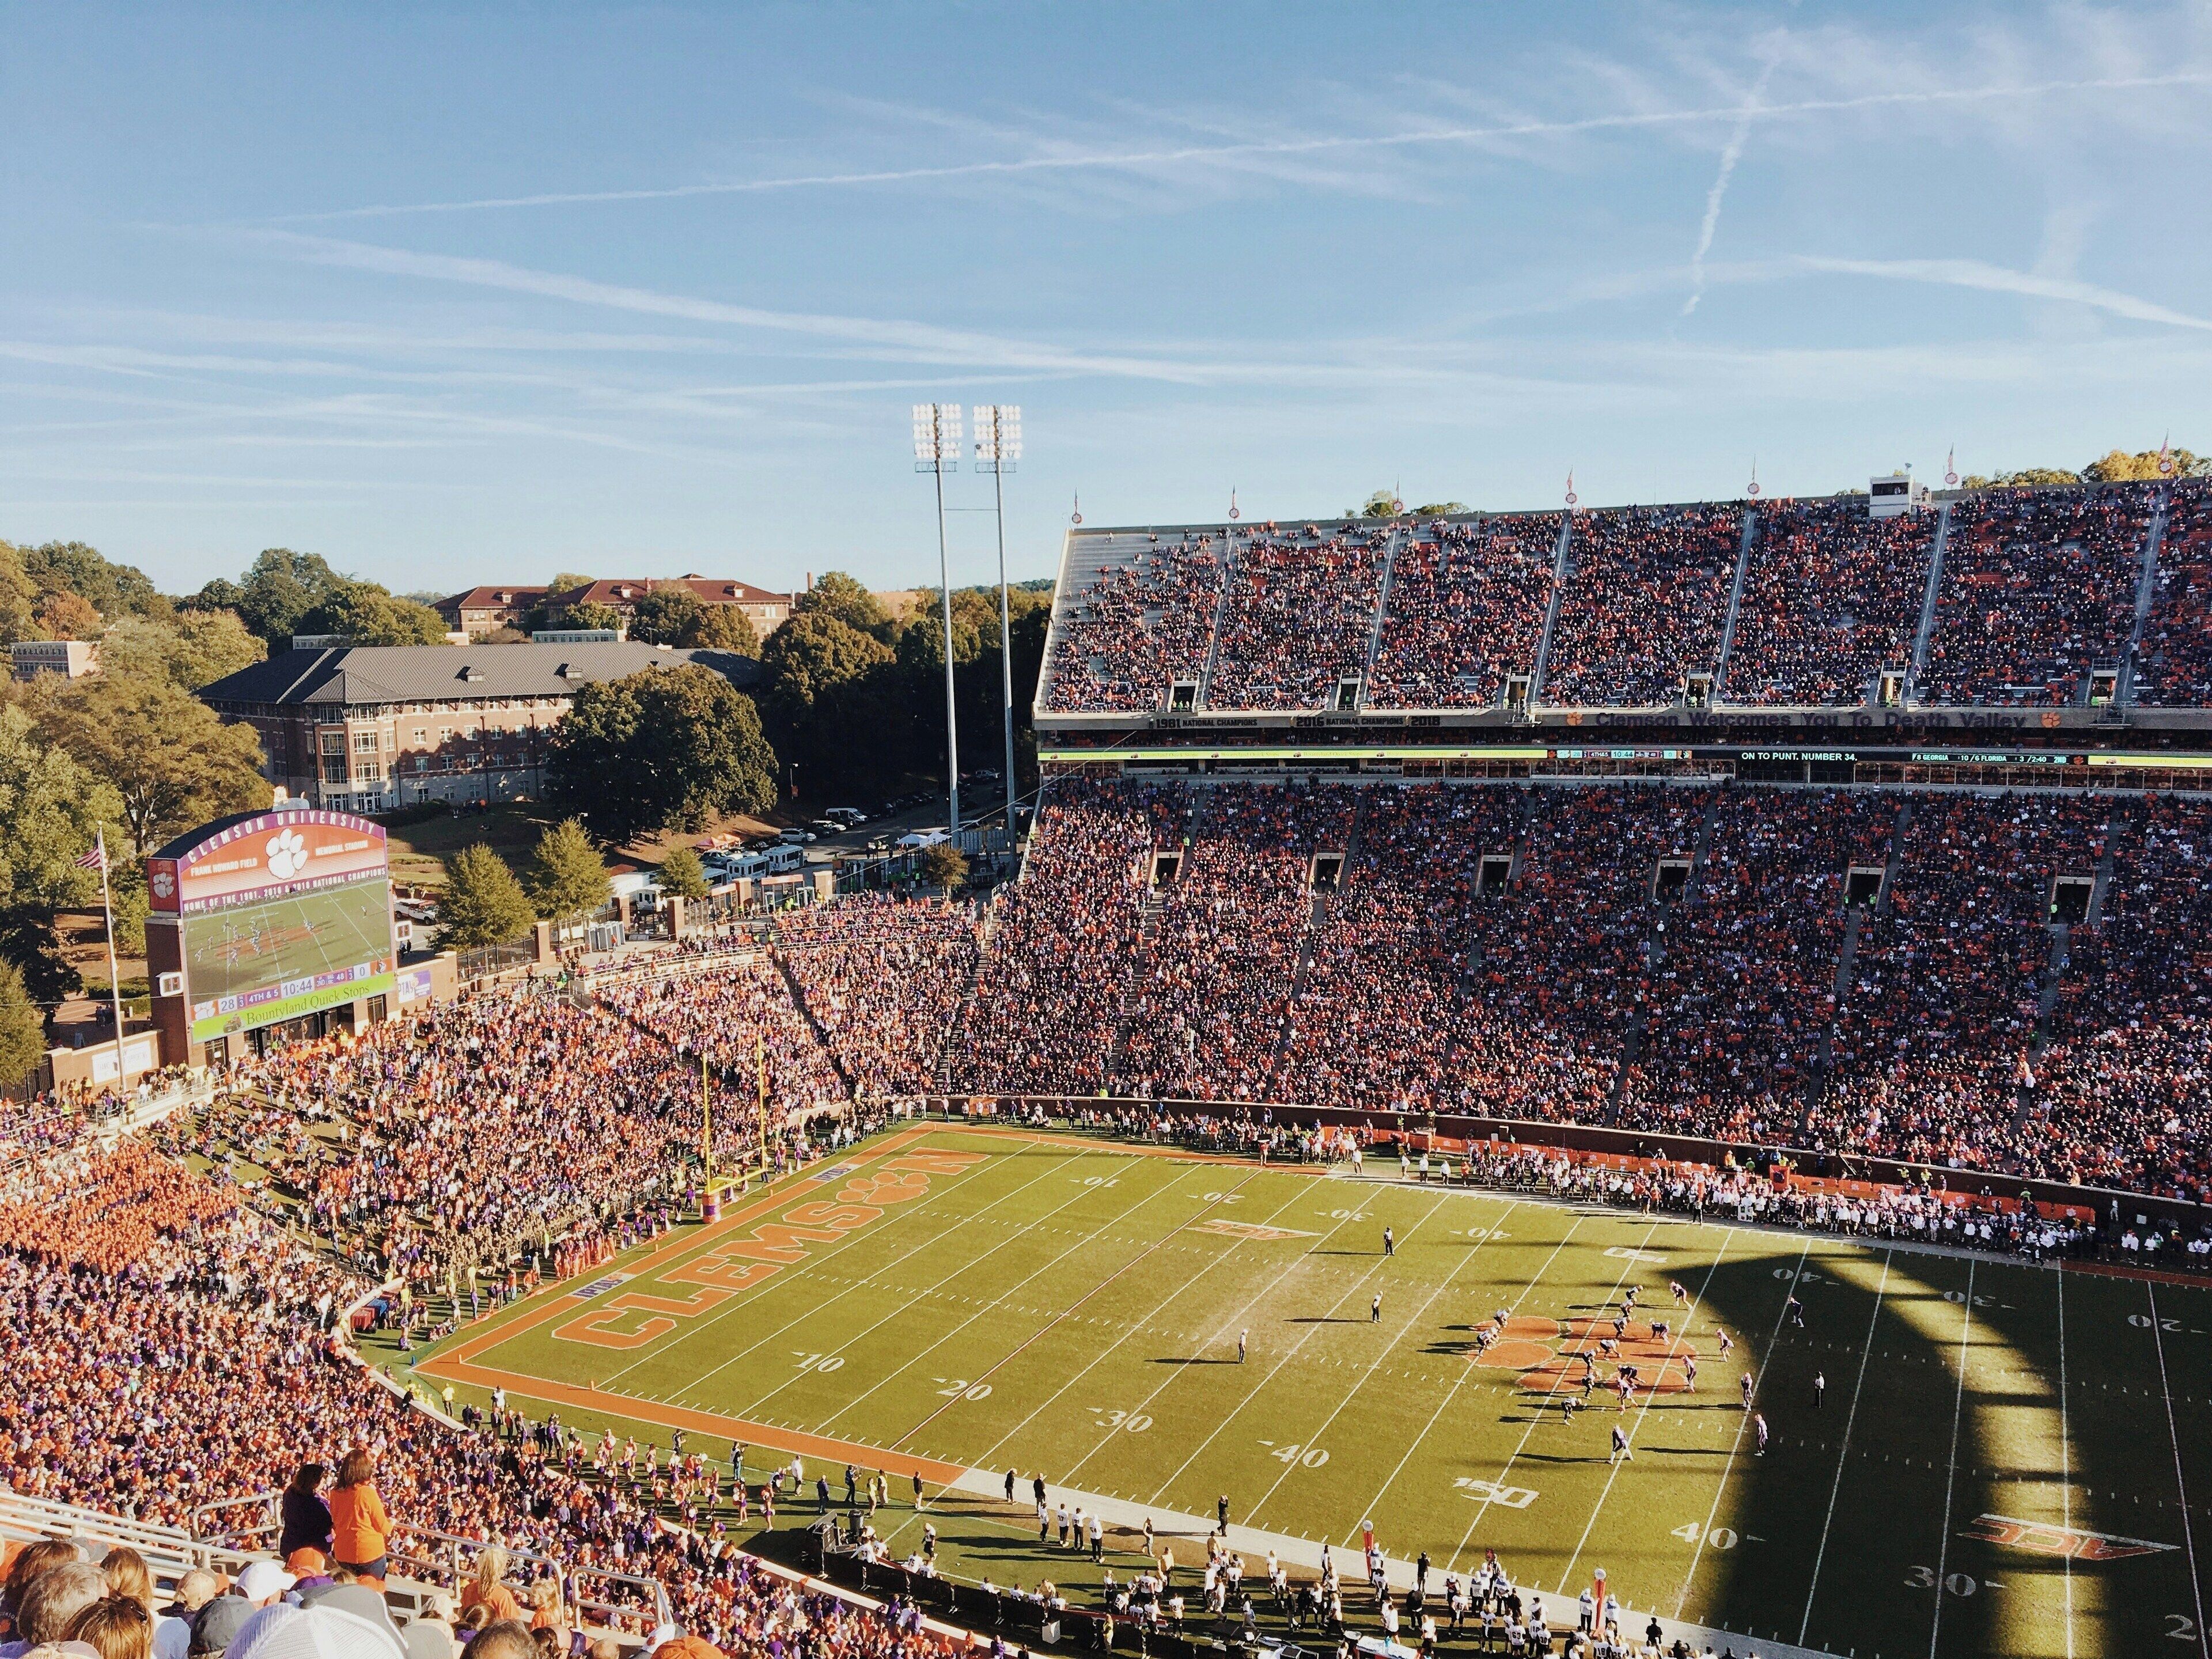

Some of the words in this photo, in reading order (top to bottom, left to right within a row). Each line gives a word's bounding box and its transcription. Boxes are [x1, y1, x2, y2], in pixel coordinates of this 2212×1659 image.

[1156, 719, 1181, 729] 1981
[1182, 719, 1215, 727] NATIONAL
[1217, 718, 1258, 727] CHAMPIONS
[1296, 717, 1324, 727] 2016
[1326, 718, 1359, 726] NATIONAL
[1361, 717, 1404, 726] CHAMPIONS
[1411, 716, 1440, 726] 2018
[1596, 713, 1680, 727] Clemson
[1688, 712, 1791, 726] Welcomes
[1801, 713, 1839, 726] You
[1851, 712, 1872, 726] To
[1885, 712, 1949, 727] Death
[1959, 712, 2027, 728] Valley
[1772, 752, 1799, 760] PUNT.
[1801, 752, 1842, 760] NUMBER
[187, 816, 264, 863] CLEMSON
[277, 810, 374, 835] UNIVERSITY
[315, 844, 344, 856] MEMORIAL
[344, 839, 368, 851] STADIUM
[191, 865, 212, 877] FRANK
[213, 862, 239, 874] HOWARD
[240, 858, 257, 869] FIELD
[184, 900, 206, 912] HOME
[209, 898, 218, 907] OF
[222, 895, 237, 905] THE
[263, 886, 282, 897] 2016
[313, 875, 345, 888] NATIONAL
[347, 868, 386, 881] CHAMPIONS
[359, 967, 365, 976] 0
[249, 993, 264, 1003] 4TH
[274, 989, 279, 997] 5
[283, 979, 312, 997] 10:44
[221, 999, 234, 1012] 28
[239, 999, 244, 1007] 3
[247, 998, 306, 1025] Bountyland
[310, 991, 340, 1009] Quick
[343, 985, 370, 998] Stops
[1084, 1177, 1123, 1188] 10
[1202, 1191, 1245, 1205] 20
[1331, 1209, 1375, 1222] 30
[1467, 1227, 1512, 1241] 40
[551, 1146, 992, 1350] CLEMSN
[1772, 1268, 1823, 1283] 40
[1942, 1290, 1996, 1307] 30
[2127, 1314, 2182, 1332] 20
[797, 1352, 846, 1372] 10
[936, 1379, 993, 1402] 20
[1094, 1410, 1154, 1433] 30
[1270, 1444, 1330, 1468] 40
[1671, 1522, 1738, 1550] 40
[1903, 1565, 1976, 1597] 30
[2165, 1614, 2212, 1641] 2
